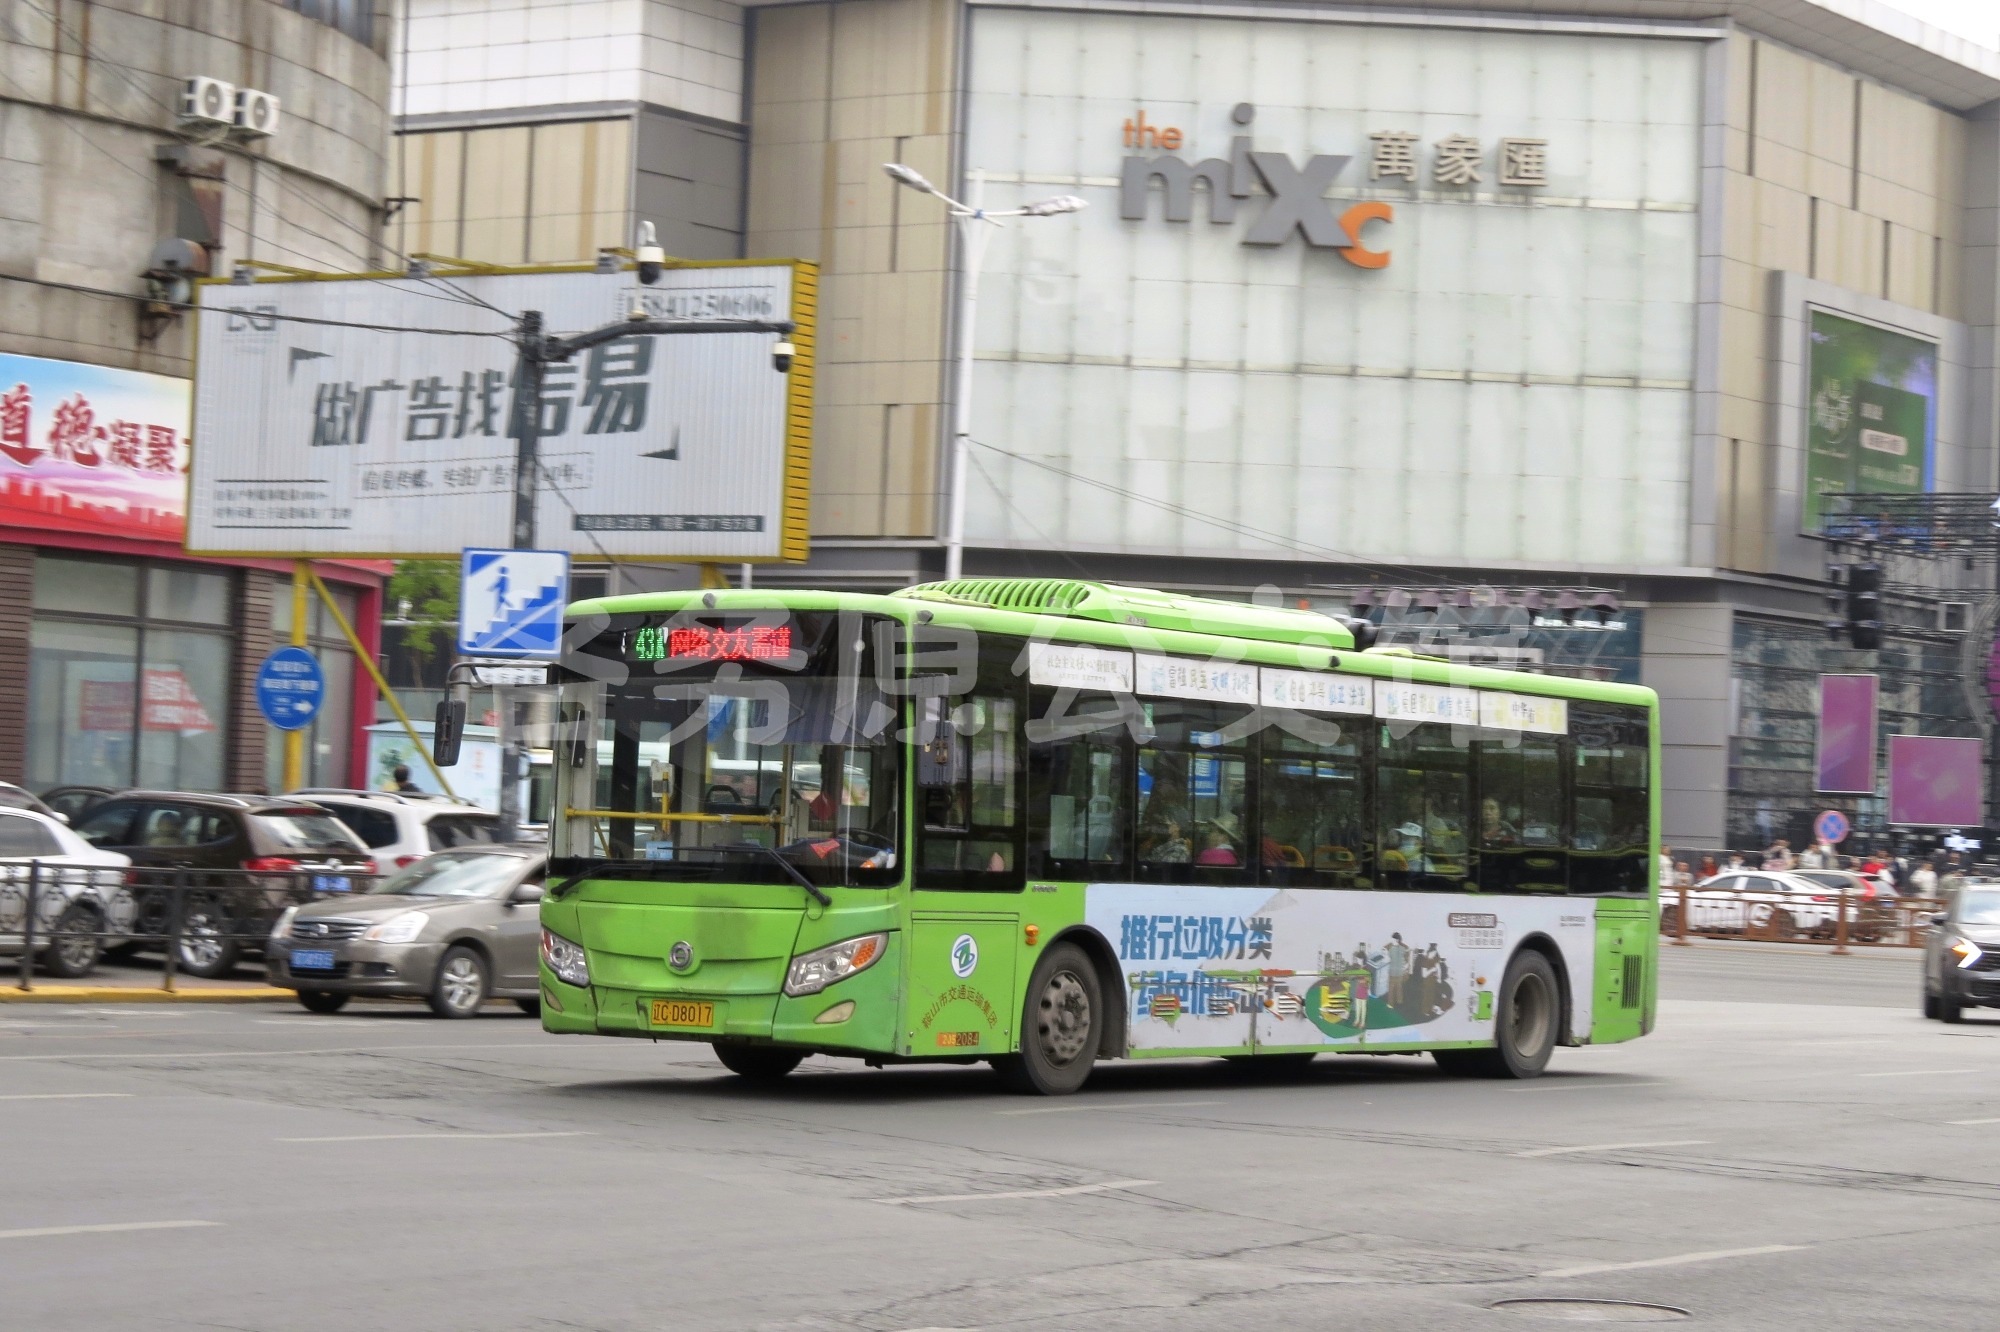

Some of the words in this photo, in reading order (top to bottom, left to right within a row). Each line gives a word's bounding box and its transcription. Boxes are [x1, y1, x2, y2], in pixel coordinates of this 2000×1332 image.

[1122, 110, 1183, 150] the
[1369, 130, 1548, 187] 萬象匯
[311, 334, 656, 448] 做广告找信易
[0, 382, 191, 469] 道德凝聚
[1120, 914, 1273, 960] 推行垃圾分类
[922, 984, 998, 1030] 鞍山市交通运输集团
